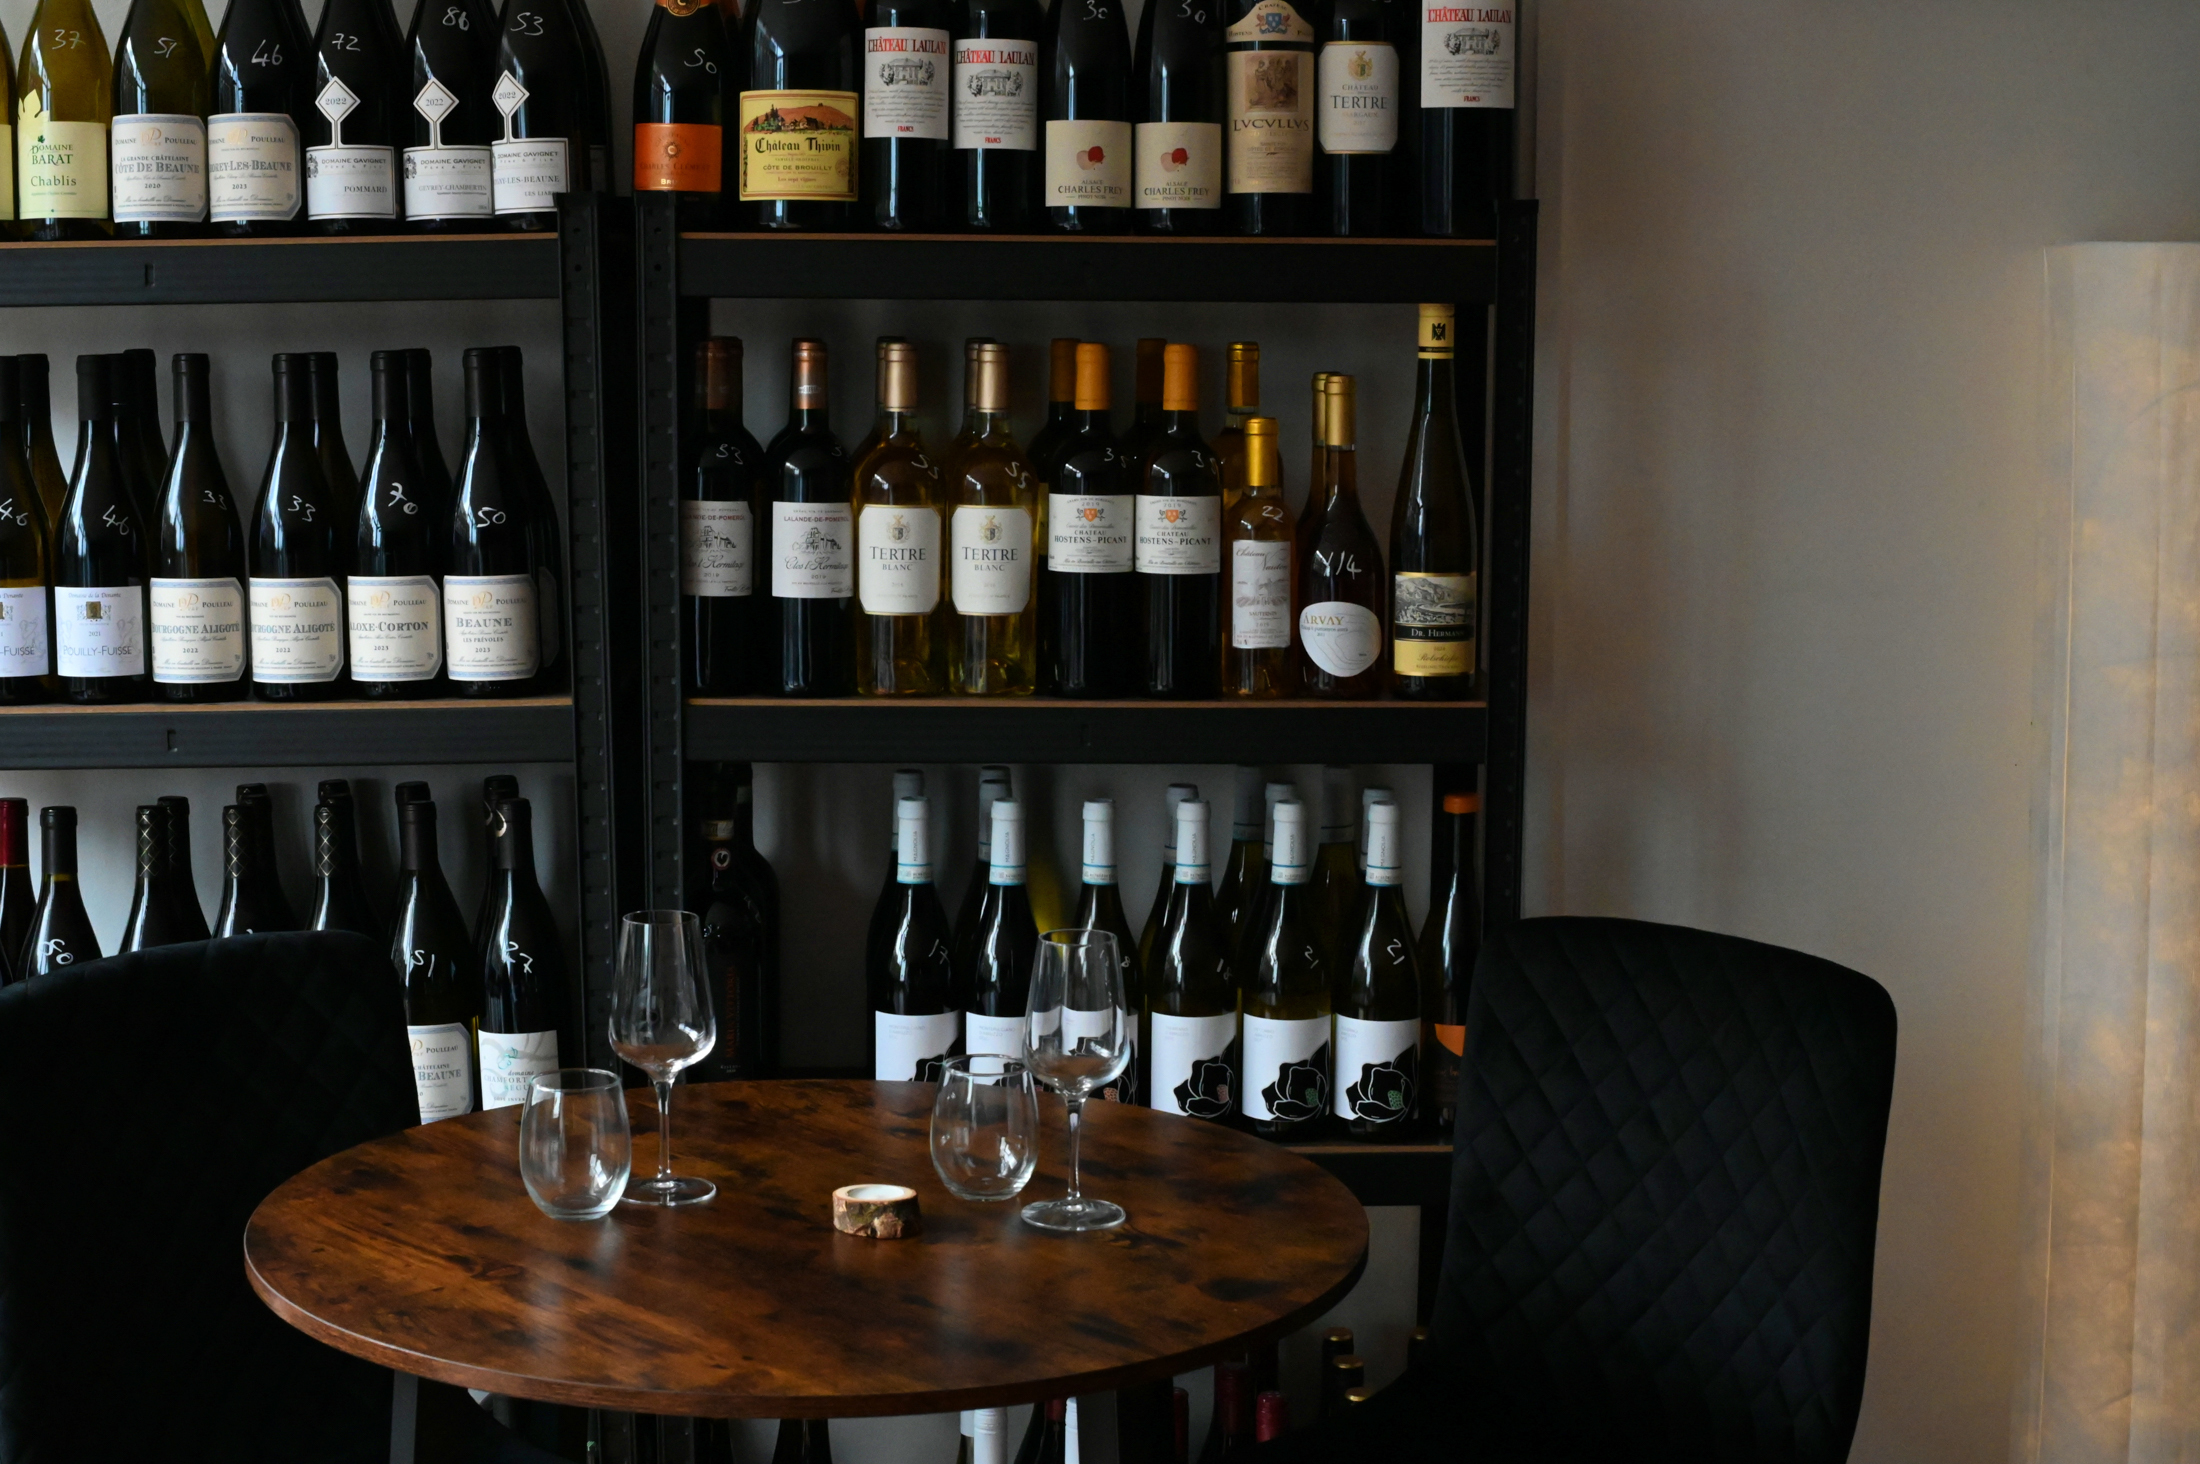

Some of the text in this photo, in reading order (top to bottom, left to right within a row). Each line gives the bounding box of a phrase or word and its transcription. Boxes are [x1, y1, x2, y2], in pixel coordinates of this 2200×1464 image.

[1427, 6, 1512, 23] CHÂTEAU LAULAN
[510, 12, 543, 36] 53
[52, 28, 86, 50] 37
[331, 33, 360, 51] 72
[867, 36, 946, 54] CHÂTEAU LAULAN
[251, 39, 283, 67] 46
[956, 48, 1034, 66] CHÂTEAU LAULAN
[684, 48, 717, 74] 50
[325, 98, 347, 106] 2022
[424, 98, 444, 107] 2022
[1330, 95, 1388, 109] TERTRE
[165, 136, 197, 145] POULLEAU
[251, 136, 285, 144] POULLEAU
[804, 137, 841, 153] Thivin
[32, 154, 74, 168] BARAT
[523, 151, 558, 159] GAVIGNET
[322, 157, 386, 166] DOMAINE GAVIGNET
[454, 158, 486, 166] GAVIGNET
[115, 161, 200, 175] CÔTE DE BEAUNE
[795, 164, 833, 172] BROUILLY
[31, 175, 77, 187] Chablis
[344, 185, 388, 194] POMMARD
[1058, 185, 1123, 196] CHARLES FREY
[1144, 187, 1210, 198] CHARLES FREY
[477, 506, 506, 528] 50
[783, 515, 850, 523] LALANDE-DE-POMEROL
[869, 546, 926, 562] TERTRE
[962, 546, 1019, 562] TERTRE
[882, 564, 912, 572] BLANC
[974, 564, 1005, 572] BLANC
[202, 601, 233, 609] POULLEAU
[393, 599, 427, 607] POULLEAU
[152, 620, 240, 635] BOURGOGNE ALIGOTÉ
[293, 620, 336, 634] ALIGOTÉ
[456, 617, 513, 629] BEAUNE
[418, 1070, 461, 1081] BEAUNE
